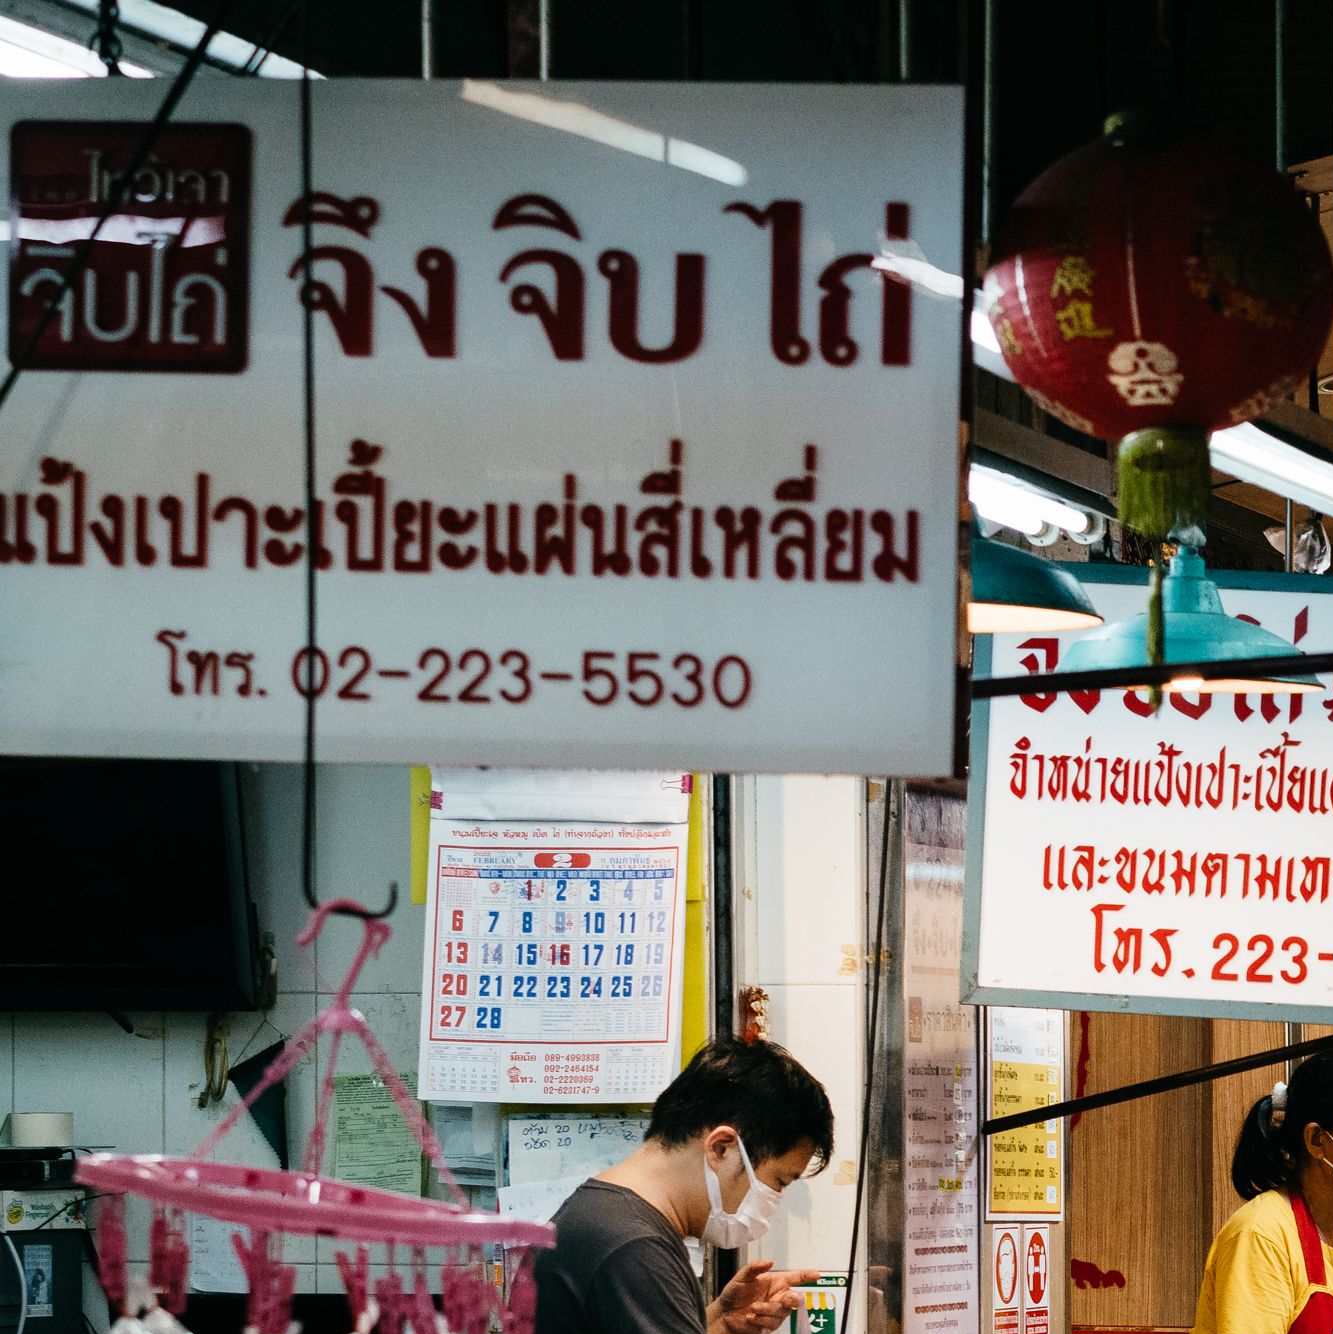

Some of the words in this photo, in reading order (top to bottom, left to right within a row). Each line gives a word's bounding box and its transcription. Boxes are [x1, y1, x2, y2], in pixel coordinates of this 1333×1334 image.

[283, 191, 457, 361] จึง
[494, 192, 708, 366] จิบ
[723, 199, 914, 368] ไถ่
[156, 629, 267, 699] โทร.
[292, 645, 754, 711] 02-223-5530
[473, 856, 517, 864] FEBRUARY
[552, 853, 573, 868] 2
[526, 880, 533, 901] 1
[556, 880, 567, 901] 2
[590, 880, 600, 901] 3
[624, 880, 633, 901] 4
[654, 880, 663, 901] 5
[452, 910, 463, 931] 6
[488, 912, 499, 933] 7
[522, 912, 533, 933] 8
[555, 912, 565, 933] 9
[584, 912, 605, 934] 10
[619, 912, 636, 934] 11
[648, 911, 666, 933] 12
[444, 942, 468, 964] 13
[480, 943, 502, 965] 14
[516, 943, 538, 966] 15
[549, 944, 570, 966] 16
[582, 944, 604, 966] 17
[616, 944, 635, 966] 18
[643, 943, 663, 965] 19
[1090, 903, 1196, 981] โทร.
[442, 974, 468, 996] 20
[479, 975, 502, 997] 21
[513, 976, 537, 997] 22
[547, 976, 571, 998] 23
[580, 976, 603, 998] 24
[610, 975, 632, 997] 25
[641, 975, 662, 997] 26
[440, 1006, 466, 1028] 27
[476, 1007, 502, 1029] 28
